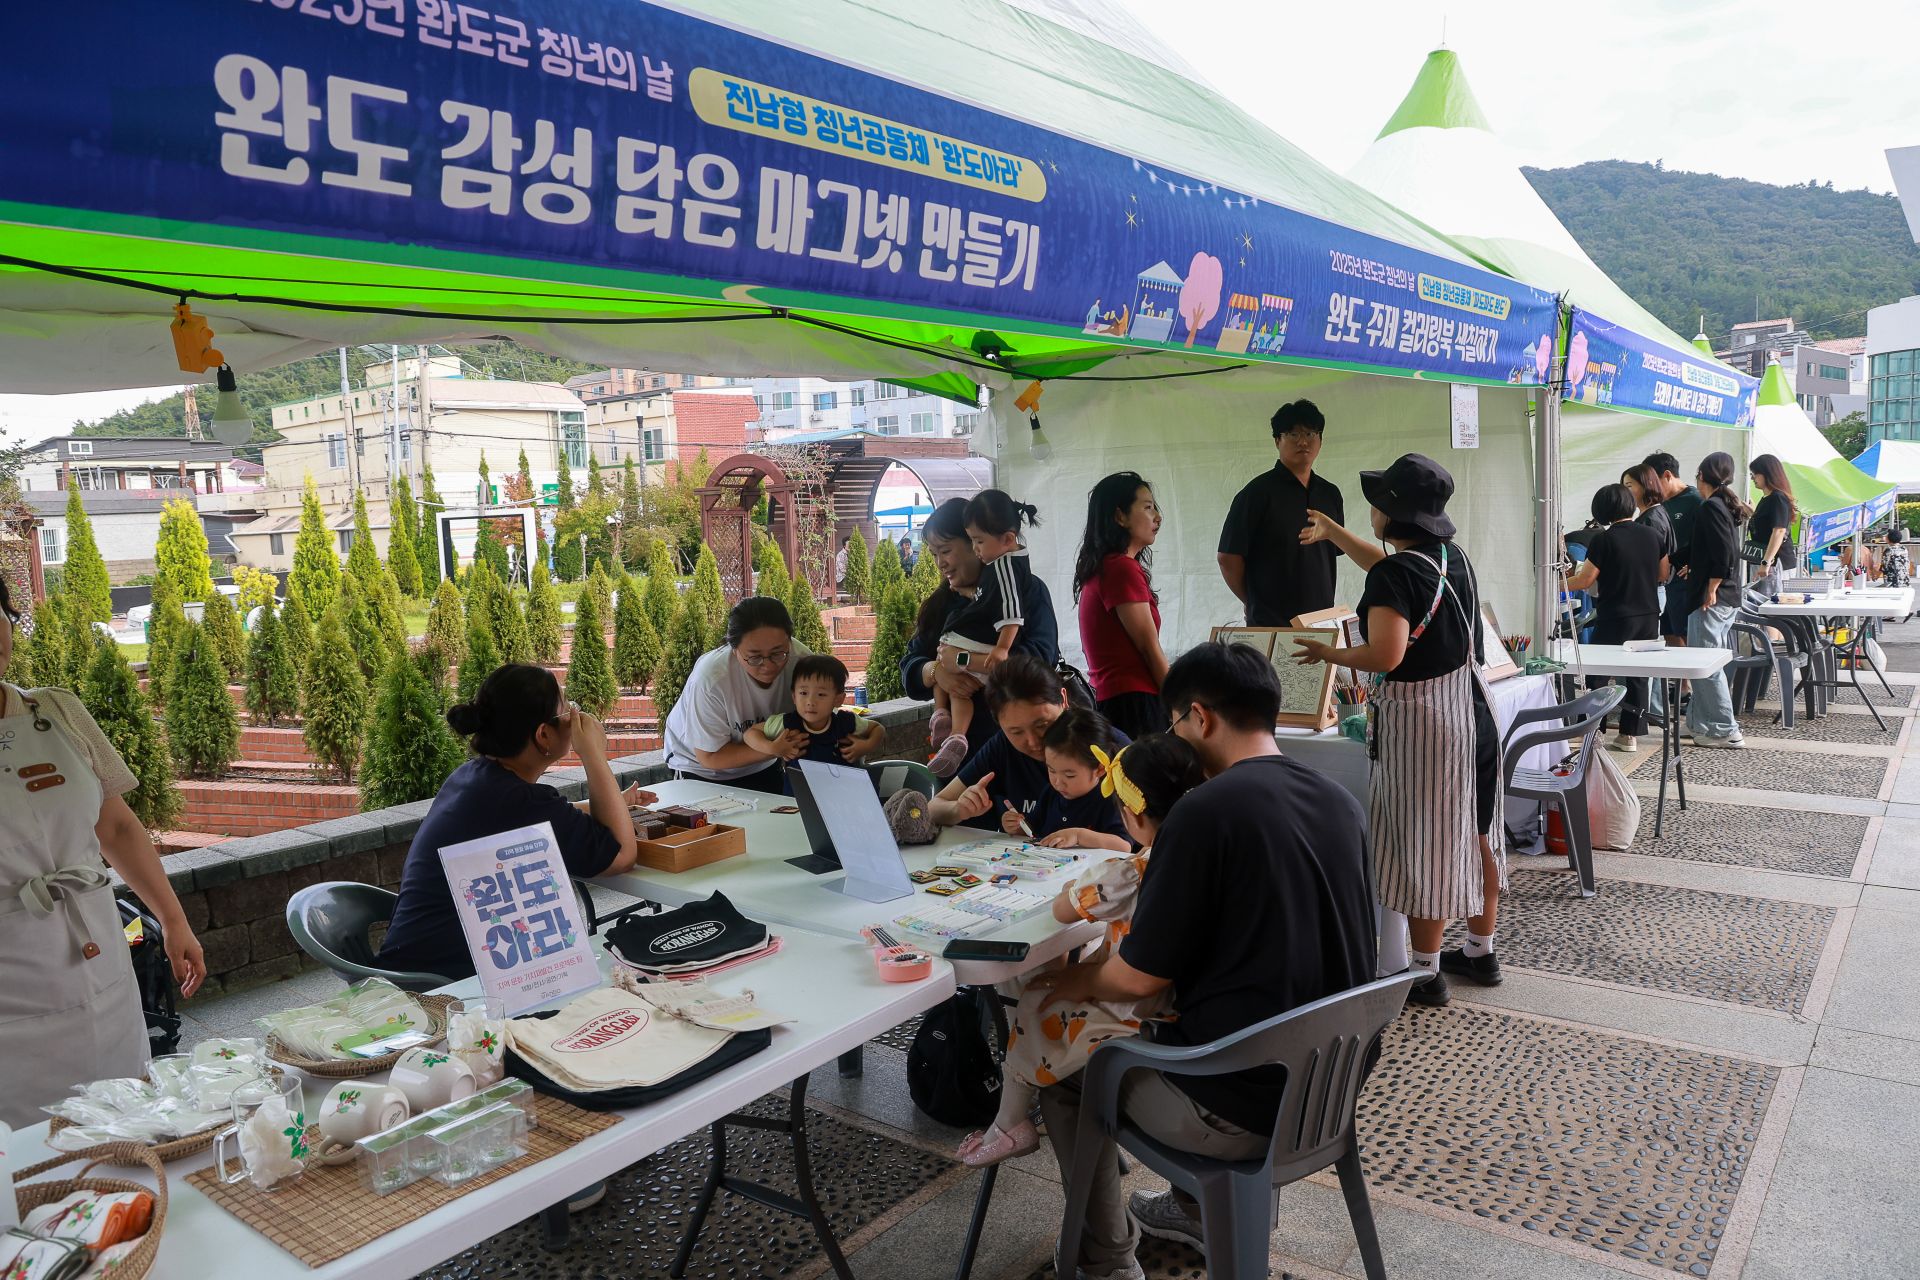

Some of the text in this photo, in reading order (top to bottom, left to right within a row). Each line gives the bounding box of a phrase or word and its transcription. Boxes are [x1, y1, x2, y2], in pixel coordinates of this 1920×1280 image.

[416, 0, 530, 67] 완도군
[537, 27, 637, 91] 청년의
[643, 55, 673, 102] 날
[722, 79, 1024, 189] 전남형 청년공동체 '완도아라'
[214, 54, 1040, 290] 완도 감성 담은 마그넷 만들기
[1329, 249, 1416, 292] 2025년 완도군 청년의 날
[1422, 277, 1442, 300] 전남형
[1442, 282, 1472, 307] 청년공동체
[1325, 292, 1499, 364] 완도 주제 컬러링북 색칠하기
[471, 860, 560, 922] 완도
[486, 907, 576, 969] 아라
[660, 926, 719, 951] HORANGGASI
[567, 1014, 641, 1050] HORANGGASI
[600, 1009, 631, 1022] WANDO
